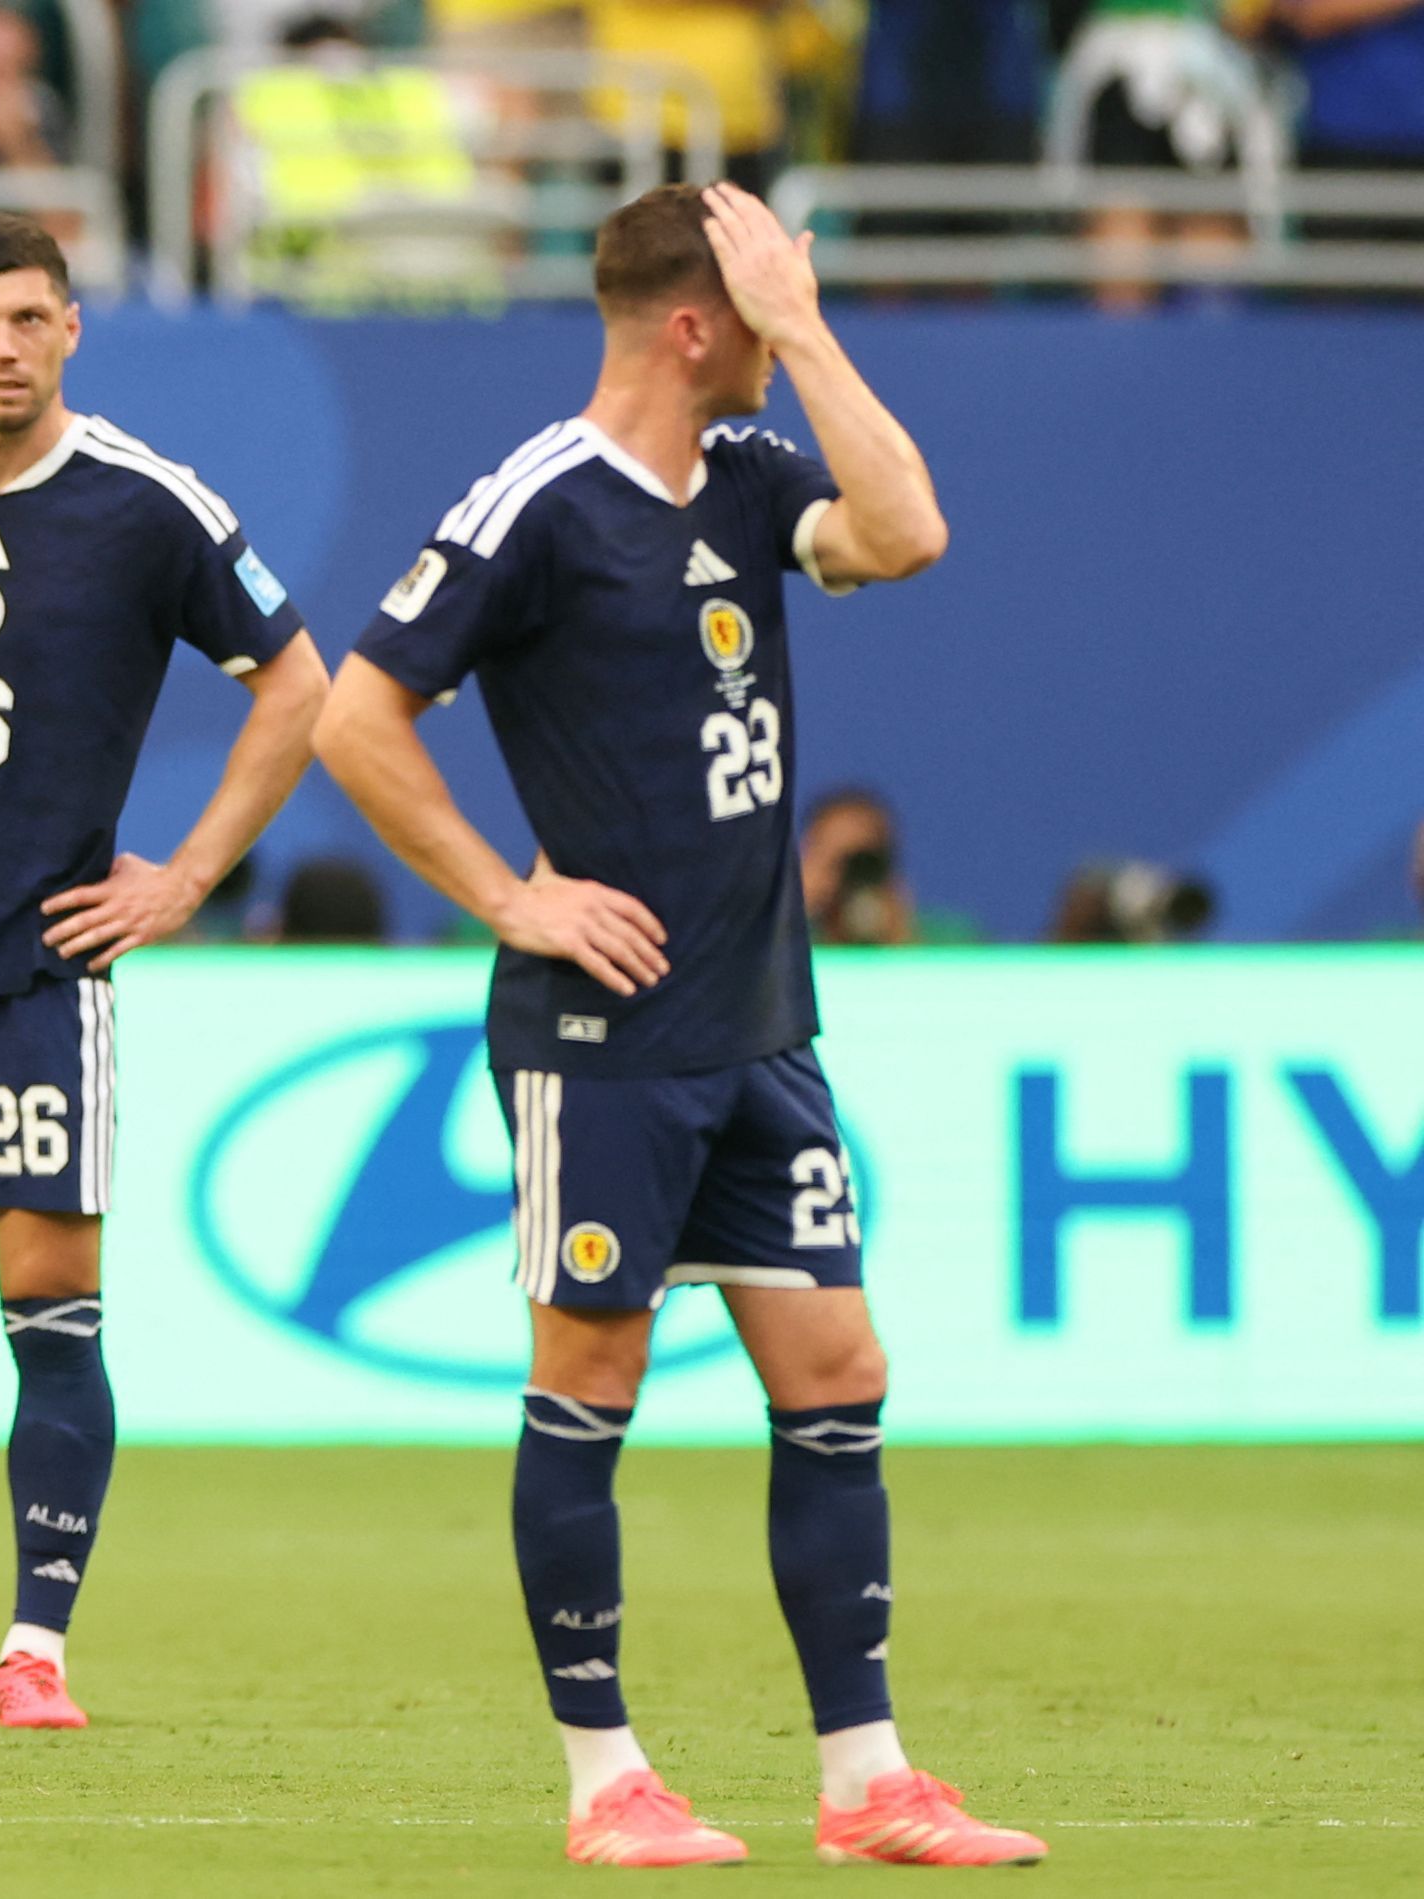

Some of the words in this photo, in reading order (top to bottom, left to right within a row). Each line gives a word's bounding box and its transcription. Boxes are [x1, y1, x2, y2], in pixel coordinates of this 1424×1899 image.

[700, 698, 783, 821] 23
[1016, 1068, 1424, 1321] HY
[25, 1502, 88, 1535] ALBA
